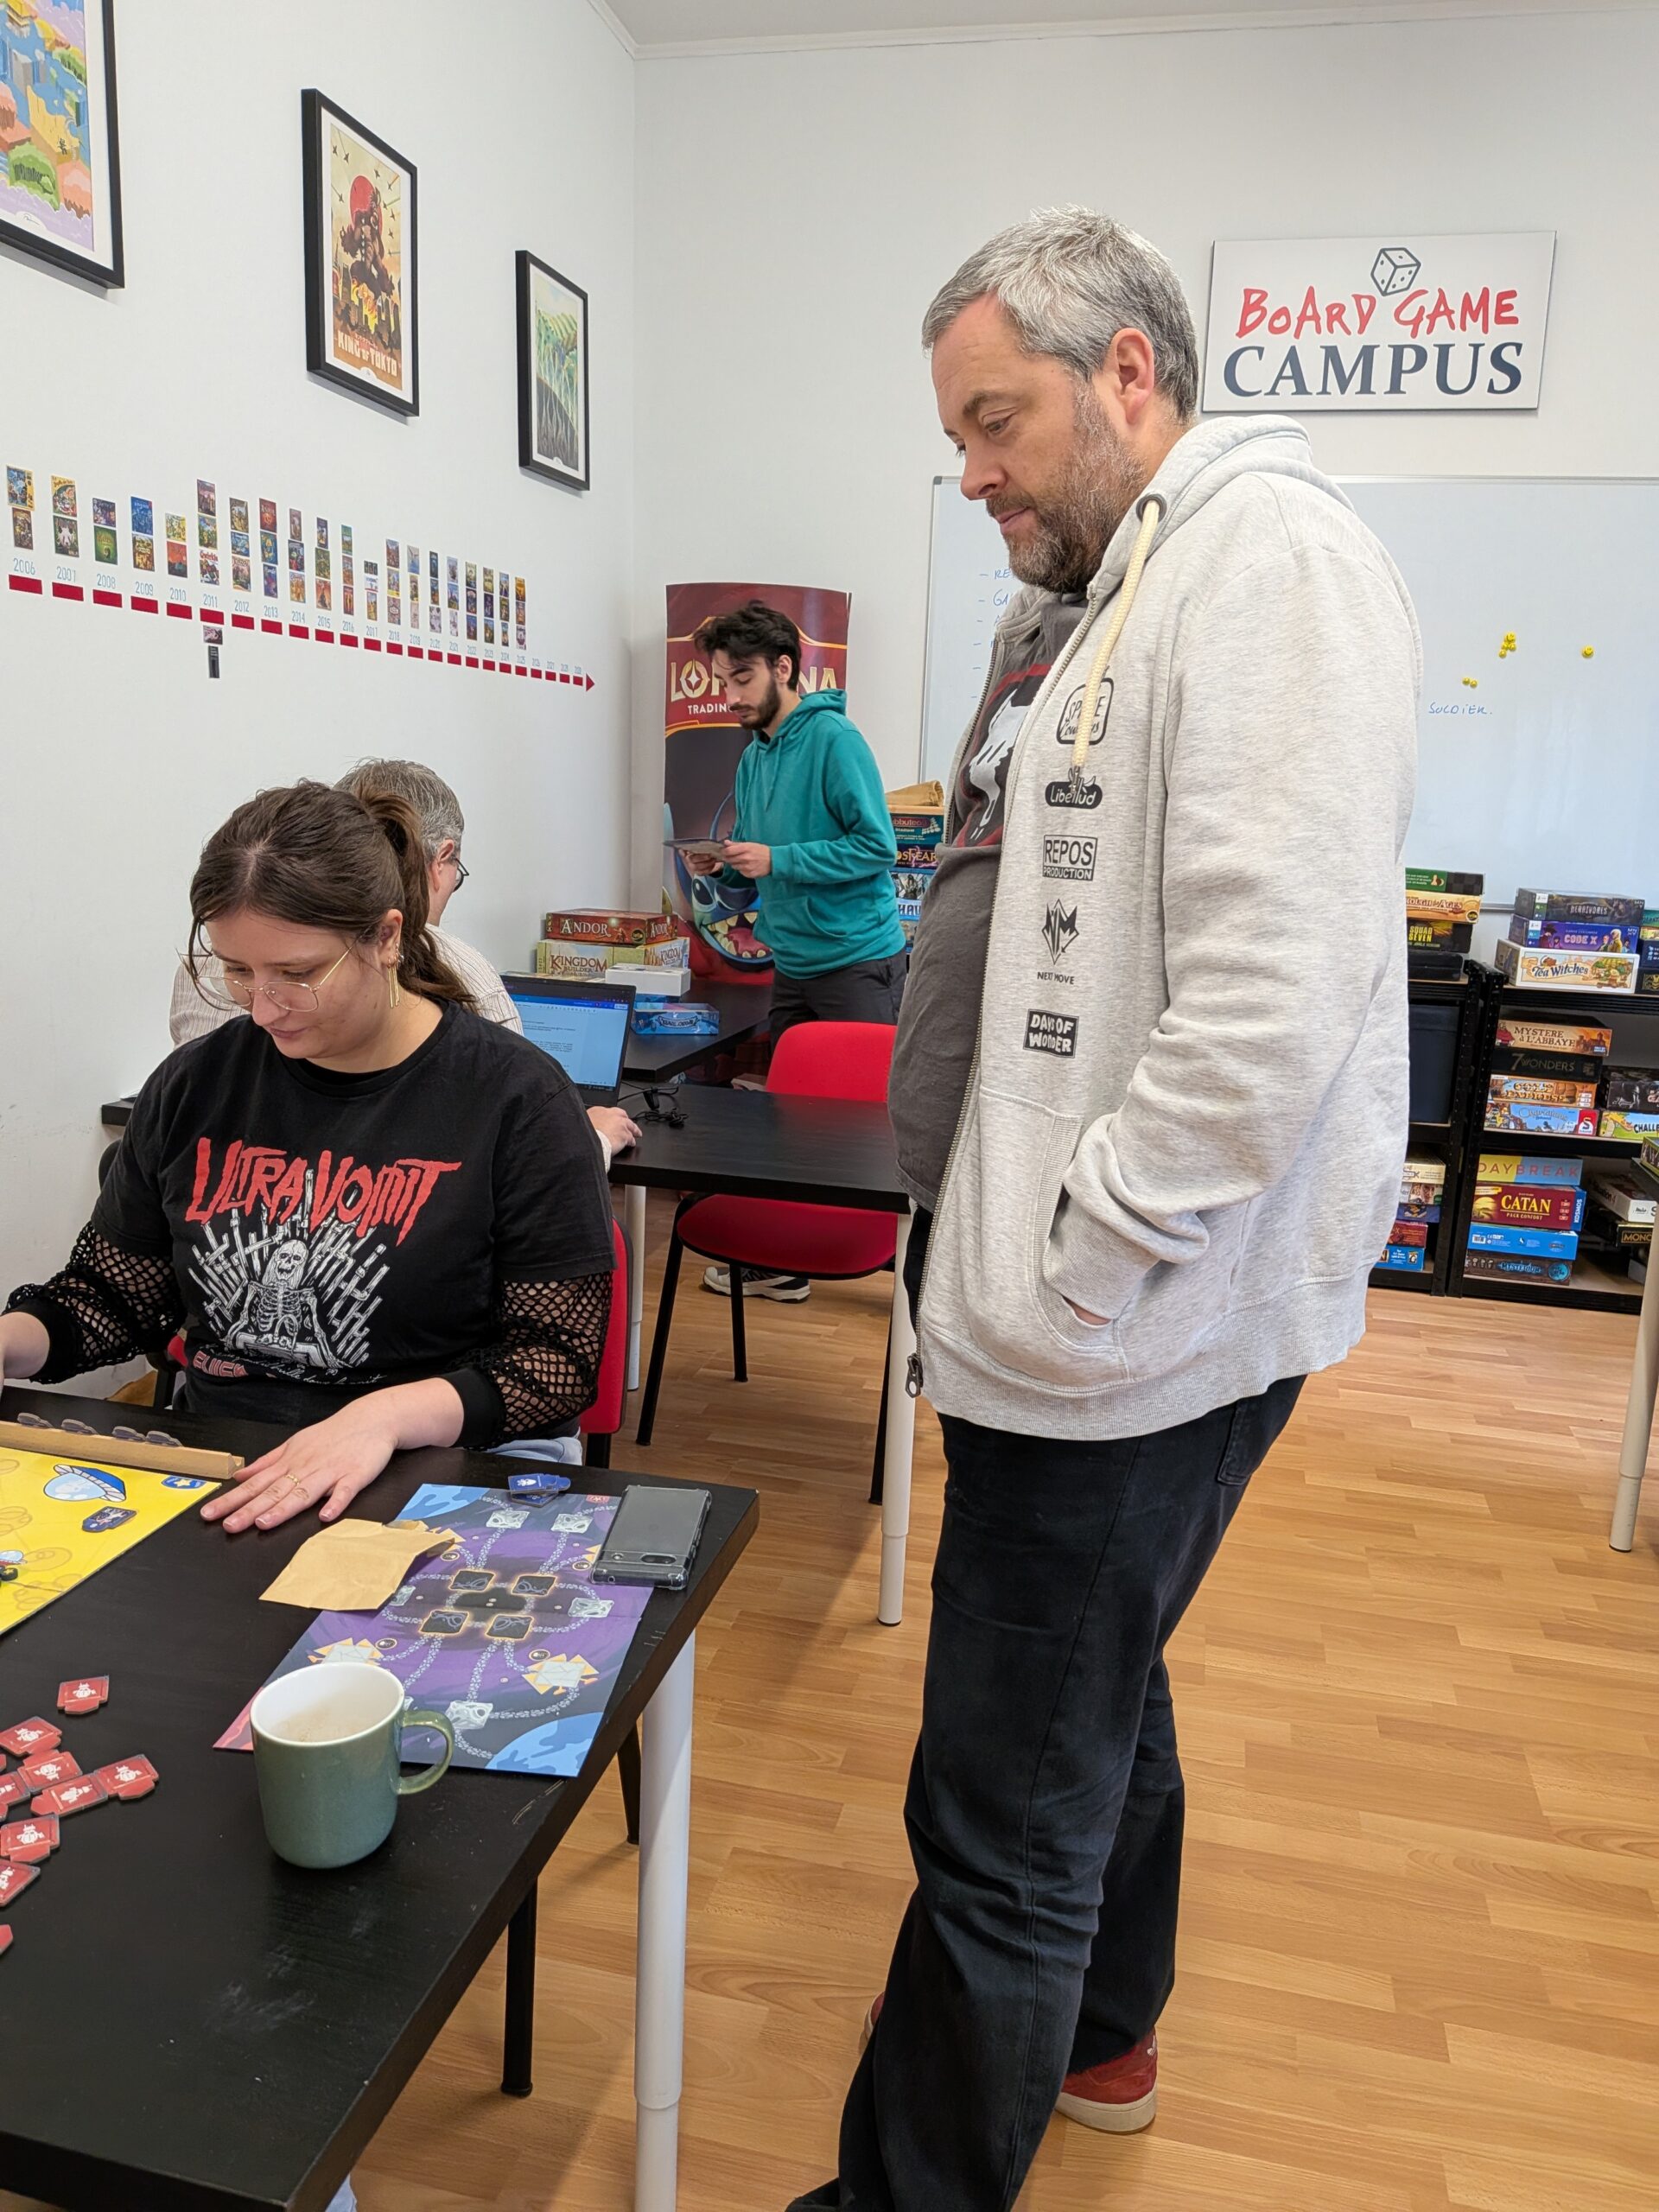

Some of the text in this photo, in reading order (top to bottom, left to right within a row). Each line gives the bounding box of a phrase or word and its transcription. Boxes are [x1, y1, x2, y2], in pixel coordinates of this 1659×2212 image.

[1236, 285, 1519, 340] BOARD GAME
[337, 329, 361, 358] KING
[369, 347, 397, 377] TOKYO
[1223, 341, 1523, 397] CAMPUS
[14, 558, 35, 575] 2006
[56, 566, 76, 582] 2007
[97, 574, 116, 589] 2008
[136, 581, 154, 596] 2009
[169, 588, 187, 601] 2010
[203, 594, 218, 607] 2011
[234, 600, 250, 613] 2012
[264, 606, 278, 618] 2013
[291, 611, 305, 624] 2014
[317, 615, 331, 628] 2015
[342, 620, 354, 632] 2016
[366, 626, 378, 637] 2017
[389, 630, 400, 641] 2018
[1065, 695, 1106, 722] SPE
[1044, 839, 1094, 866] REPOS
[1043, 867, 1093, 880] PRODUCTION
[562, 918, 612, 938] ANDOR
[650, 921, 669, 938] ANDOR
[1408, 932, 1432, 943] SEVEN
[1409, 925, 1433, 935] SQUAD
[1564, 933, 1599, 945] CODE X
[550, 955, 607, 976] KINGDOM
[1532, 963, 1589, 977] Tea Witches
[1037, 971, 1075, 985] NEXT MOVE
[1030, 1014, 1074, 1034] DAYS OF
[1028, 1032, 1071, 1053] WONDER
[1526, 1036, 1576, 1047] L'ABBAYE
[1510, 1052, 1525, 1071] 7
[1522, 1058, 1577, 1072] WONDERS
[1478, 1162, 1579, 1177] DAYBREAK
[184, 1136, 463, 1248] ULTRA VOMIT
[1501, 1194, 1552, 1213] CATAN
[1573, 1198, 1583, 1224] KOSMOS
